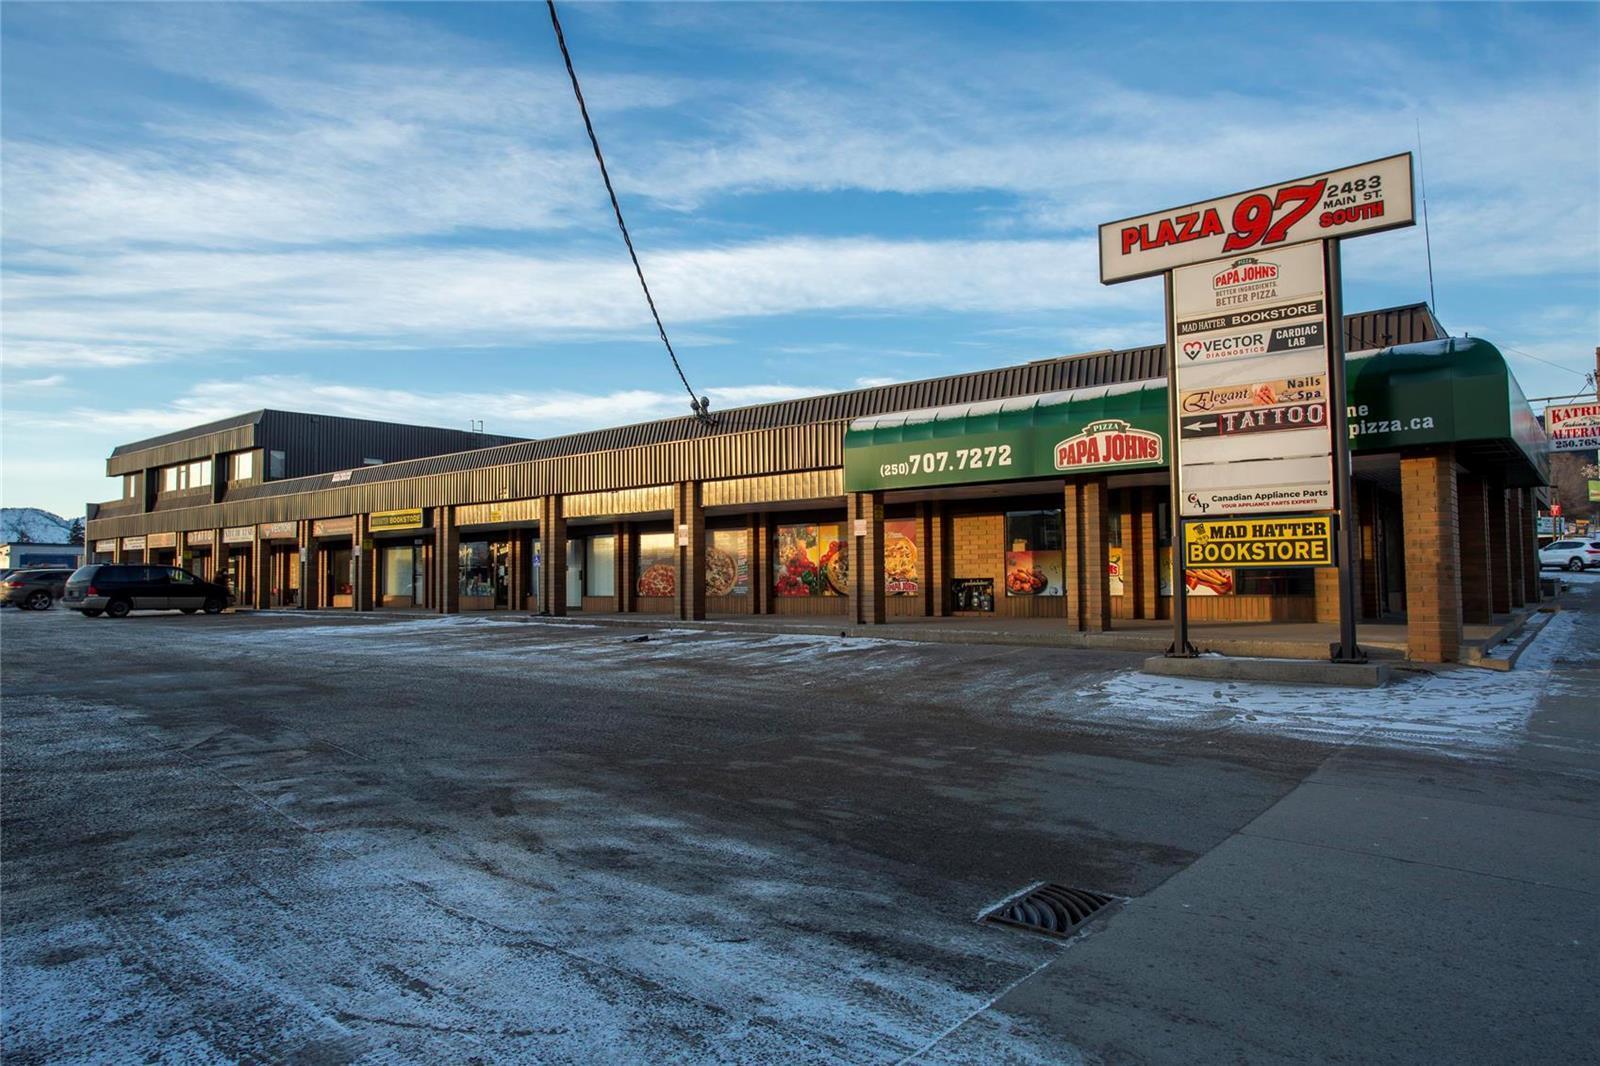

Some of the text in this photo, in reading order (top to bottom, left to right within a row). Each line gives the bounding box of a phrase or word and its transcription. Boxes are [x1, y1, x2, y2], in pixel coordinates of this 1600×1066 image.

[1326, 176, 1382, 198] 2483
[1324, 190, 1382, 210] MAIN ST.
[1122, 178, 1328, 255] PLAZA 97
[1319, 200, 1384, 228] SOUTH
[1216, 270, 1240, 286] PAPA
[1216, 288, 1236, 297] BETTER
[1216, 293, 1248, 306] BETTER
[1182, 303, 1317, 333] MAD HATTER BOOKSTORE
[1276, 325, 1317, 340] CARDIAC
[1203, 334, 1264, 352] VECTOR
[1288, 339, 1306, 348] LAB
[1206, 346, 1264, 359] DIAGNOSTICS
[1287, 377, 1321, 389] Nails
[1183, 389, 1249, 412] Elegant
[1298, 389, 1321, 401] Spa
[1222, 405, 1324, 431] TATTOO
[1093, 423, 1118, 432] PIZZA
[1059, 437, 1100, 465] PAPA
[1211, 489, 1328, 502] Canadian Appliance Parts
[1210, 522, 1326, 539] MAD HATTER
[1190, 540, 1324, 561] BOOKSTORE
